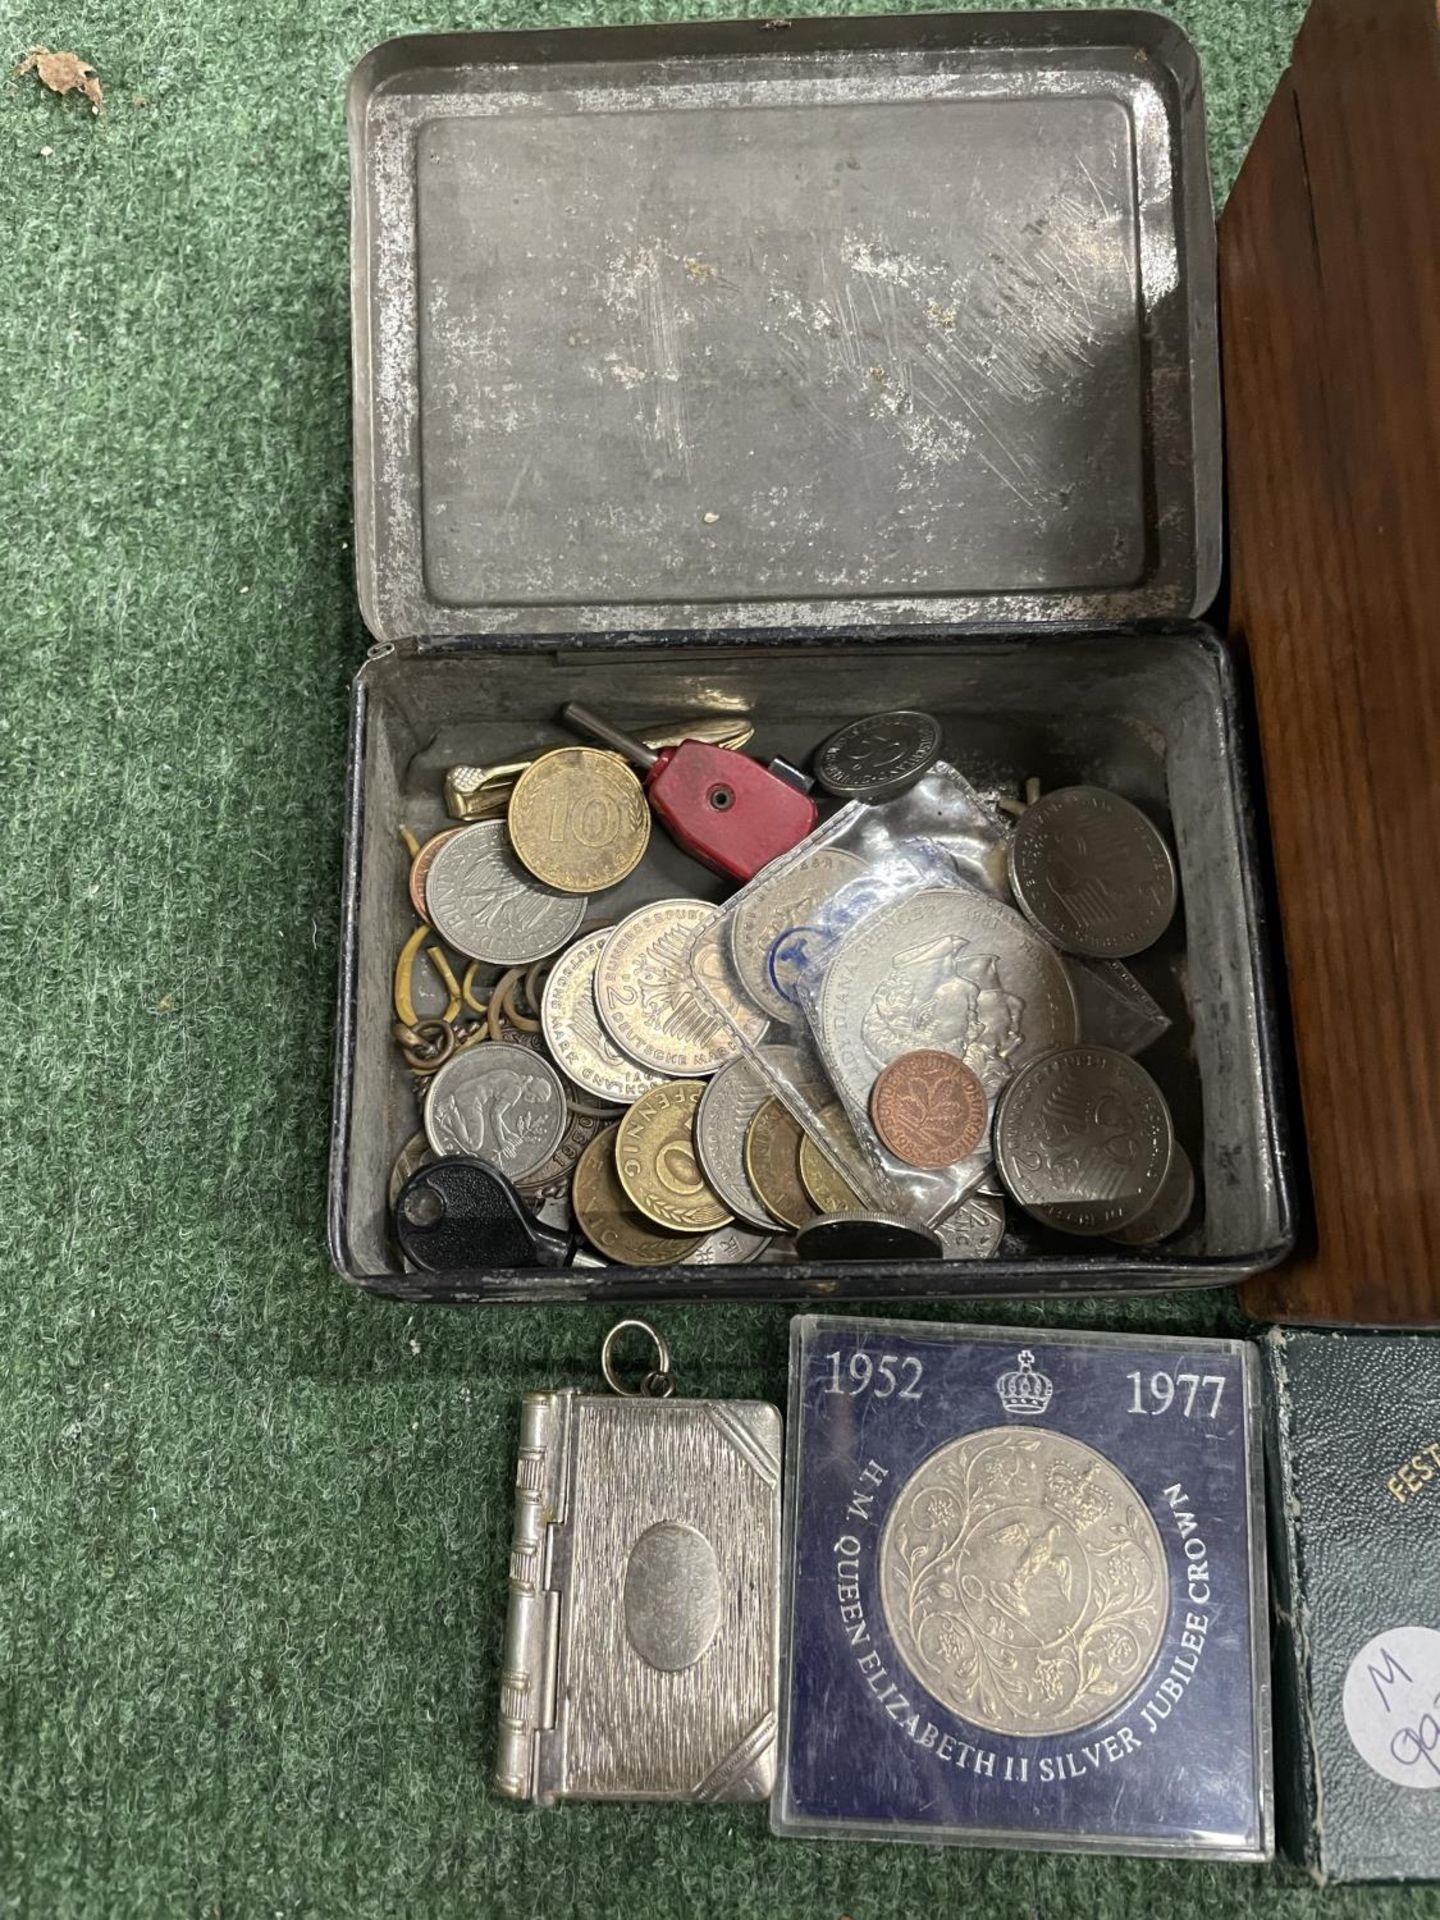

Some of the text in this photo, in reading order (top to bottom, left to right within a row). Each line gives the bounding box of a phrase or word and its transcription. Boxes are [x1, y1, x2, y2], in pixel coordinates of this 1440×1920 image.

[549, 794, 620, 849] 10
[606, 983, 638, 1011] 2
[834, 963, 859, 1030] DIANA
[551, 1013, 580, 1066] MARK
[612, 1011, 688, 1066] DEUTSCHE
[552, 1115, 595, 1168] 1950
[1011, 1150, 1042, 1179] 2
[825, 1351, 924, 1399] 1952
[1126, 1371, 1226, 1419] 1977
[1163, 1483, 1211, 1604] CROWN
[833, 1535, 871, 1646] QUEEN
[1140, 1612, 1209, 1734] JUBILEE
[857, 1650, 996, 1777] ELIZABETH
[1039, 1727, 1143, 1783] SILVER
